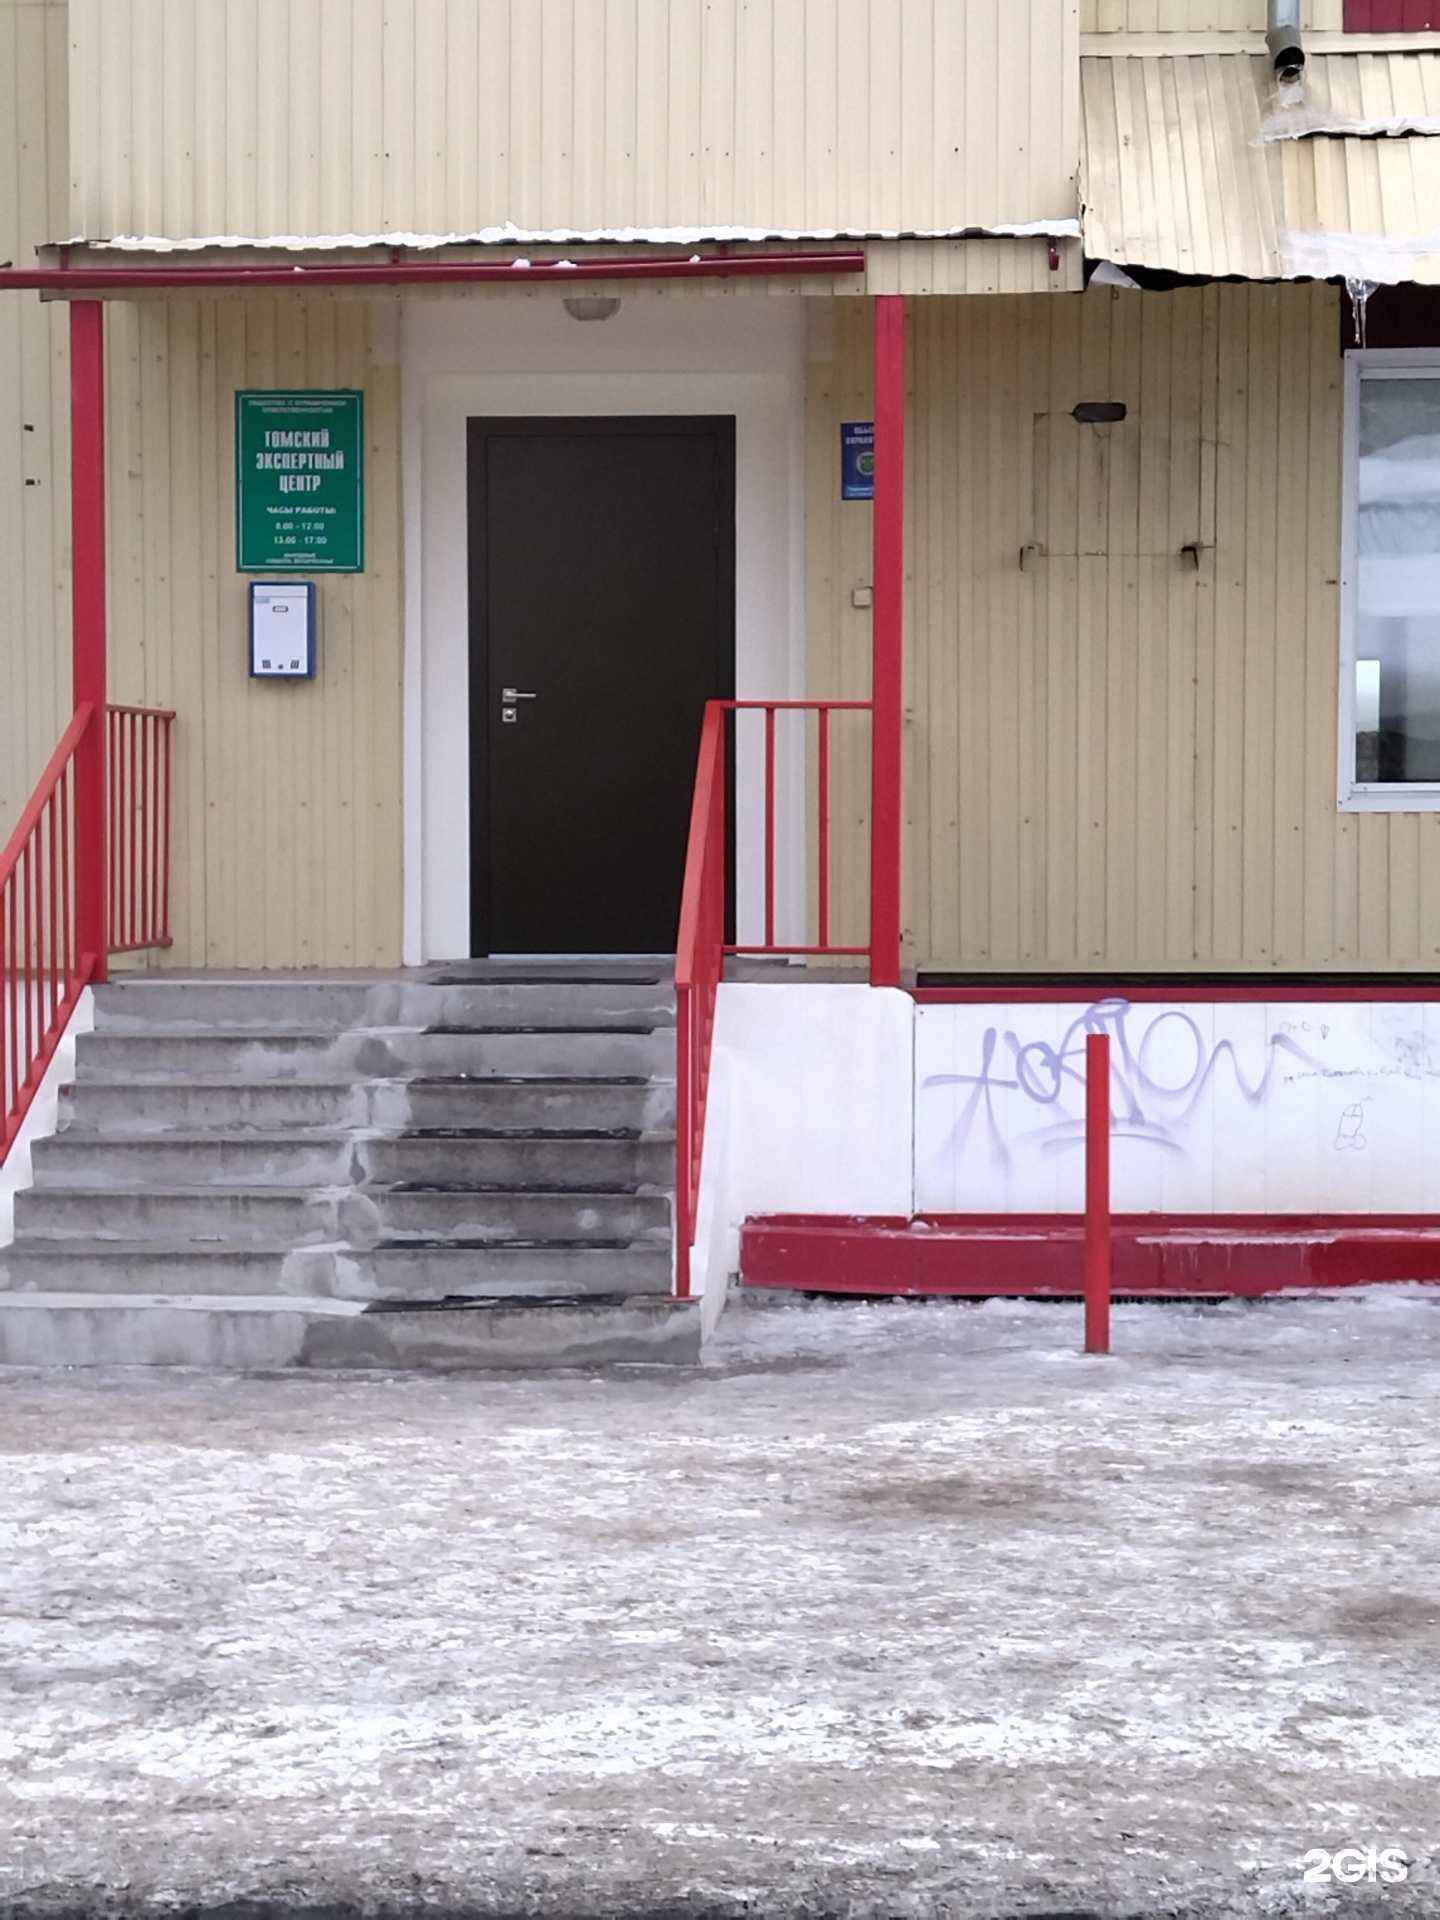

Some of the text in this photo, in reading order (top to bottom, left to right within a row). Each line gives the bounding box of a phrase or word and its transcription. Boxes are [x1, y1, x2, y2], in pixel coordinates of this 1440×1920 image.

[265, 428, 330, 448] ТОМСКИЙ
[256, 450, 344, 469] ЭКСПЕРТНЫЙ
[279, 474, 321, 493] ЦЕНТР
